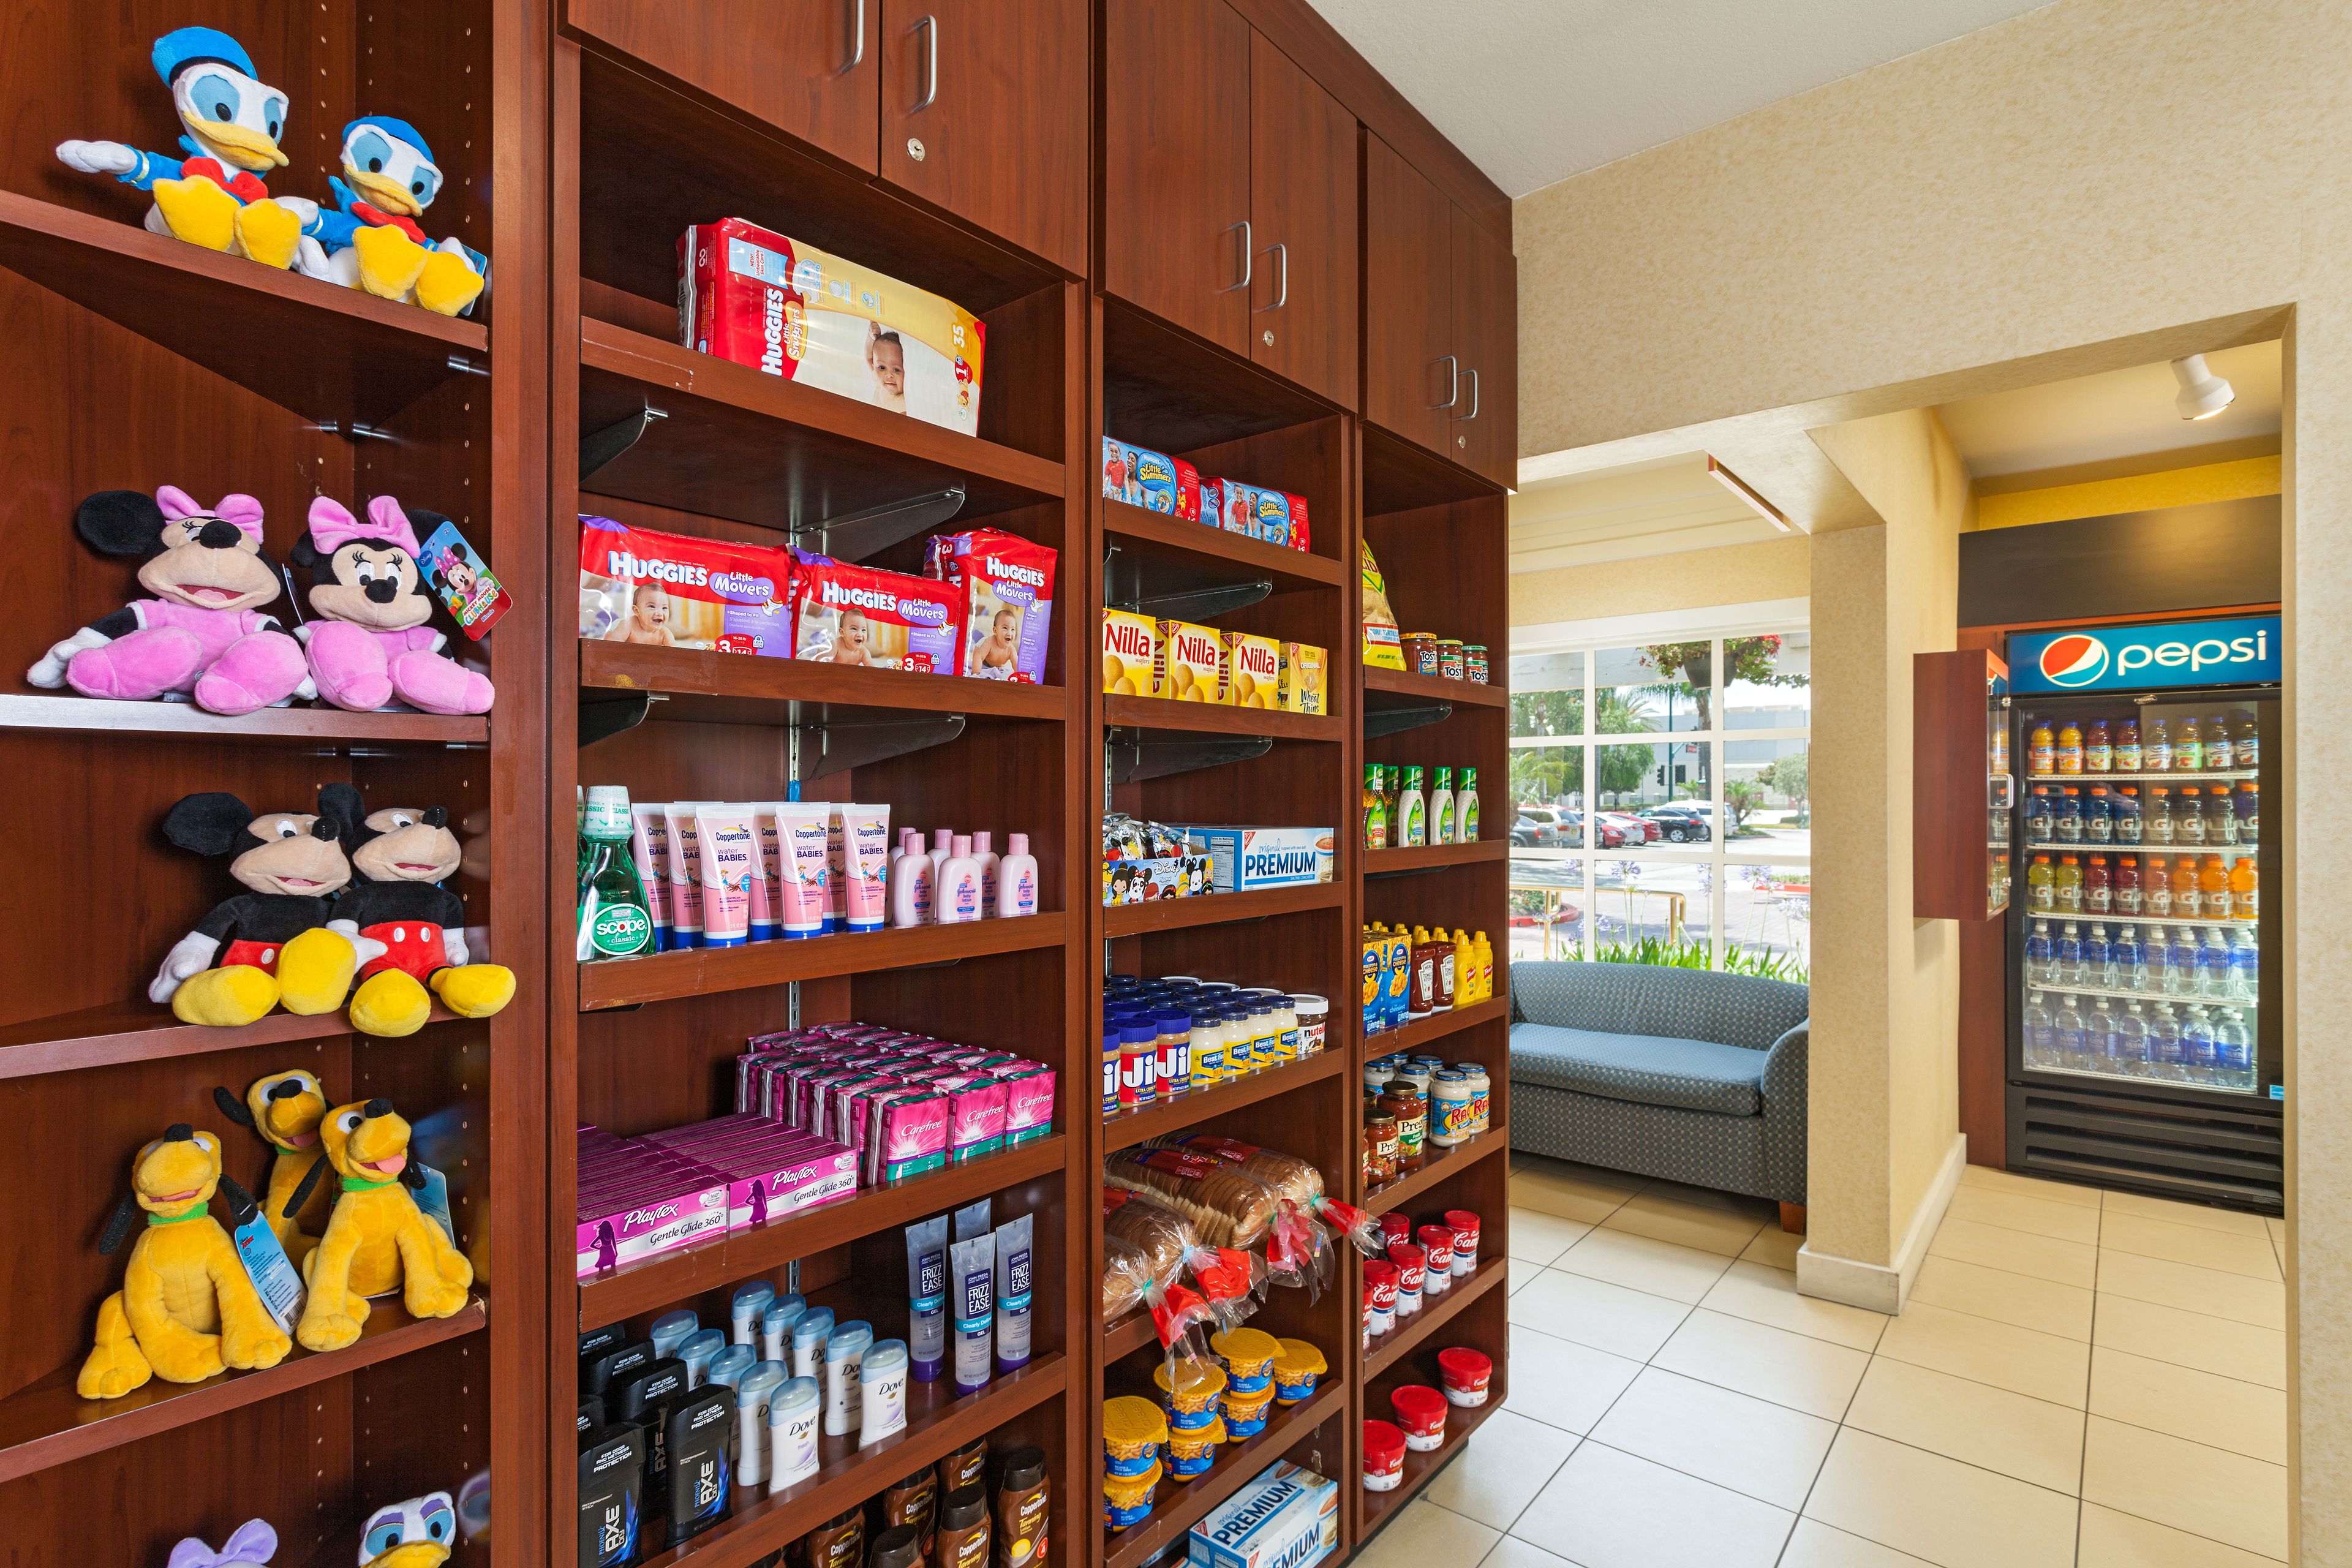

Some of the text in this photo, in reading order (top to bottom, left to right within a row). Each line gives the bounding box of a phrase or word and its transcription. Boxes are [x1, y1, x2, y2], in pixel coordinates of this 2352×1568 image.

[761, 287, 784, 376] HUGGIES
[788, 308, 803, 357] Snugglers
[953, 324, 965, 348] 35
[1140, 467, 1171, 483] Swimmers
[1145, 463, 1161, 473] Little
[1259, 506, 1285, 517] Swimmers
[421, 552, 432, 565] Disney
[608, 551, 708, 587] HUGGIES
[729, 571, 753, 582] Little
[986, 556, 1044, 587] HUGGIES
[714, 576, 770, 596] Movers
[996, 582, 1033, 601] Movers
[1006, 580, 1022, 589] Little
[464, 587, 491, 616] MICKEY MOUSE
[822, 581, 897, 611] HUGGIES
[913, 598, 931, 607] Little
[465, 590, 498, 625] CLUBHOUSE
[481, 608, 494, 622] Minnie
[902, 602, 944, 619] Movers
[718, 640, 731, 653] 3
[1105, 623, 1150, 657] Nilla
[1177, 635, 1216, 666] Nilla
[2117, 630, 2267, 676] pepsi
[904, 657, 914, 671] 3
[1240, 646, 1275, 674] Nilla
[1300, 688, 1319, 703] Wheat
[1300, 703, 1319, 714] Thins
[716, 832, 751, 843] Coppertone
[796, 829, 827, 839] Coppertone
[858, 828, 886, 837] Coppertone
[1259, 838, 1280, 856] original
[718, 853, 747, 862] BABIES
[1245, 851, 1316, 876] PREMIUM
[1153, 860, 1181, 877] Disney
[2119, 889, 2131, 899] G
[2153, 892, 2165, 903] G
[2183, 892, 2194, 903] G
[2210, 892, 2222, 903] G
[597, 919, 646, 936] scope
[1390, 1004, 1405, 1013] cheesiest
[1017, 1093, 1052, 1109] Carefree
[967, 1104, 1004, 1123] Carefree
[901, 1120, 942, 1137] Carefree
[965, 1134, 981, 1142] original
[899, 1148, 918, 1158] original
[772, 1166, 818, 1191] Playtex
[794, 1177, 854, 1204] Gentle Glide 360°
[624, 1204, 679, 1232] Playtex
[650, 1213, 723, 1246] Gentle Glide 360°
[922, 1265, 941, 1281] FRIZZ
[1011, 1263, 1029, 1280] FRIZZ
[922, 1276, 943, 1292] EASE
[1012, 1275, 1030, 1291] EASE
[968, 1284, 989, 1301] FRIZZ
[969, 1295, 990, 1313] EASE
[612, 1359, 646, 1376] PROTECTION
[625, 1355, 643, 1365] WETNESS
[645, 1382, 678, 1400] PROTECTION
[658, 1378, 676, 1389] WETNESS
[879, 1378, 904, 1395] Dove
[703, 1405, 723, 1419] WETNESS
[707, 1404, 718, 1412] ODOR
[692, 1410, 724, 1430] PROTECTION
[790, 1415, 816, 1436] Dove
[608, 1446, 630, 1460] WETNESS
[612, 1444, 625, 1453] ODOR
[655, 1432, 666, 1472] AXE
[797, 1441, 810, 1450] fresh
[594, 1451, 632, 1473] PROTECTION
[701, 1460, 714, 1505] AXE
[1020, 1496, 1047, 1517] Coppertone
[1212, 1480, 1298, 1545] PREMIUM
[1218, 1503, 1242, 1526] original
[605, 1504, 620, 1552] AXE
[1019, 1512, 1041, 1528] Tanning
[831, 1531, 861, 1556] Coppertone
[959, 1533, 987, 1558] Coppertone
[829, 1550, 854, 1568] Tanning
[957, 1551, 981, 1568] Tanning
